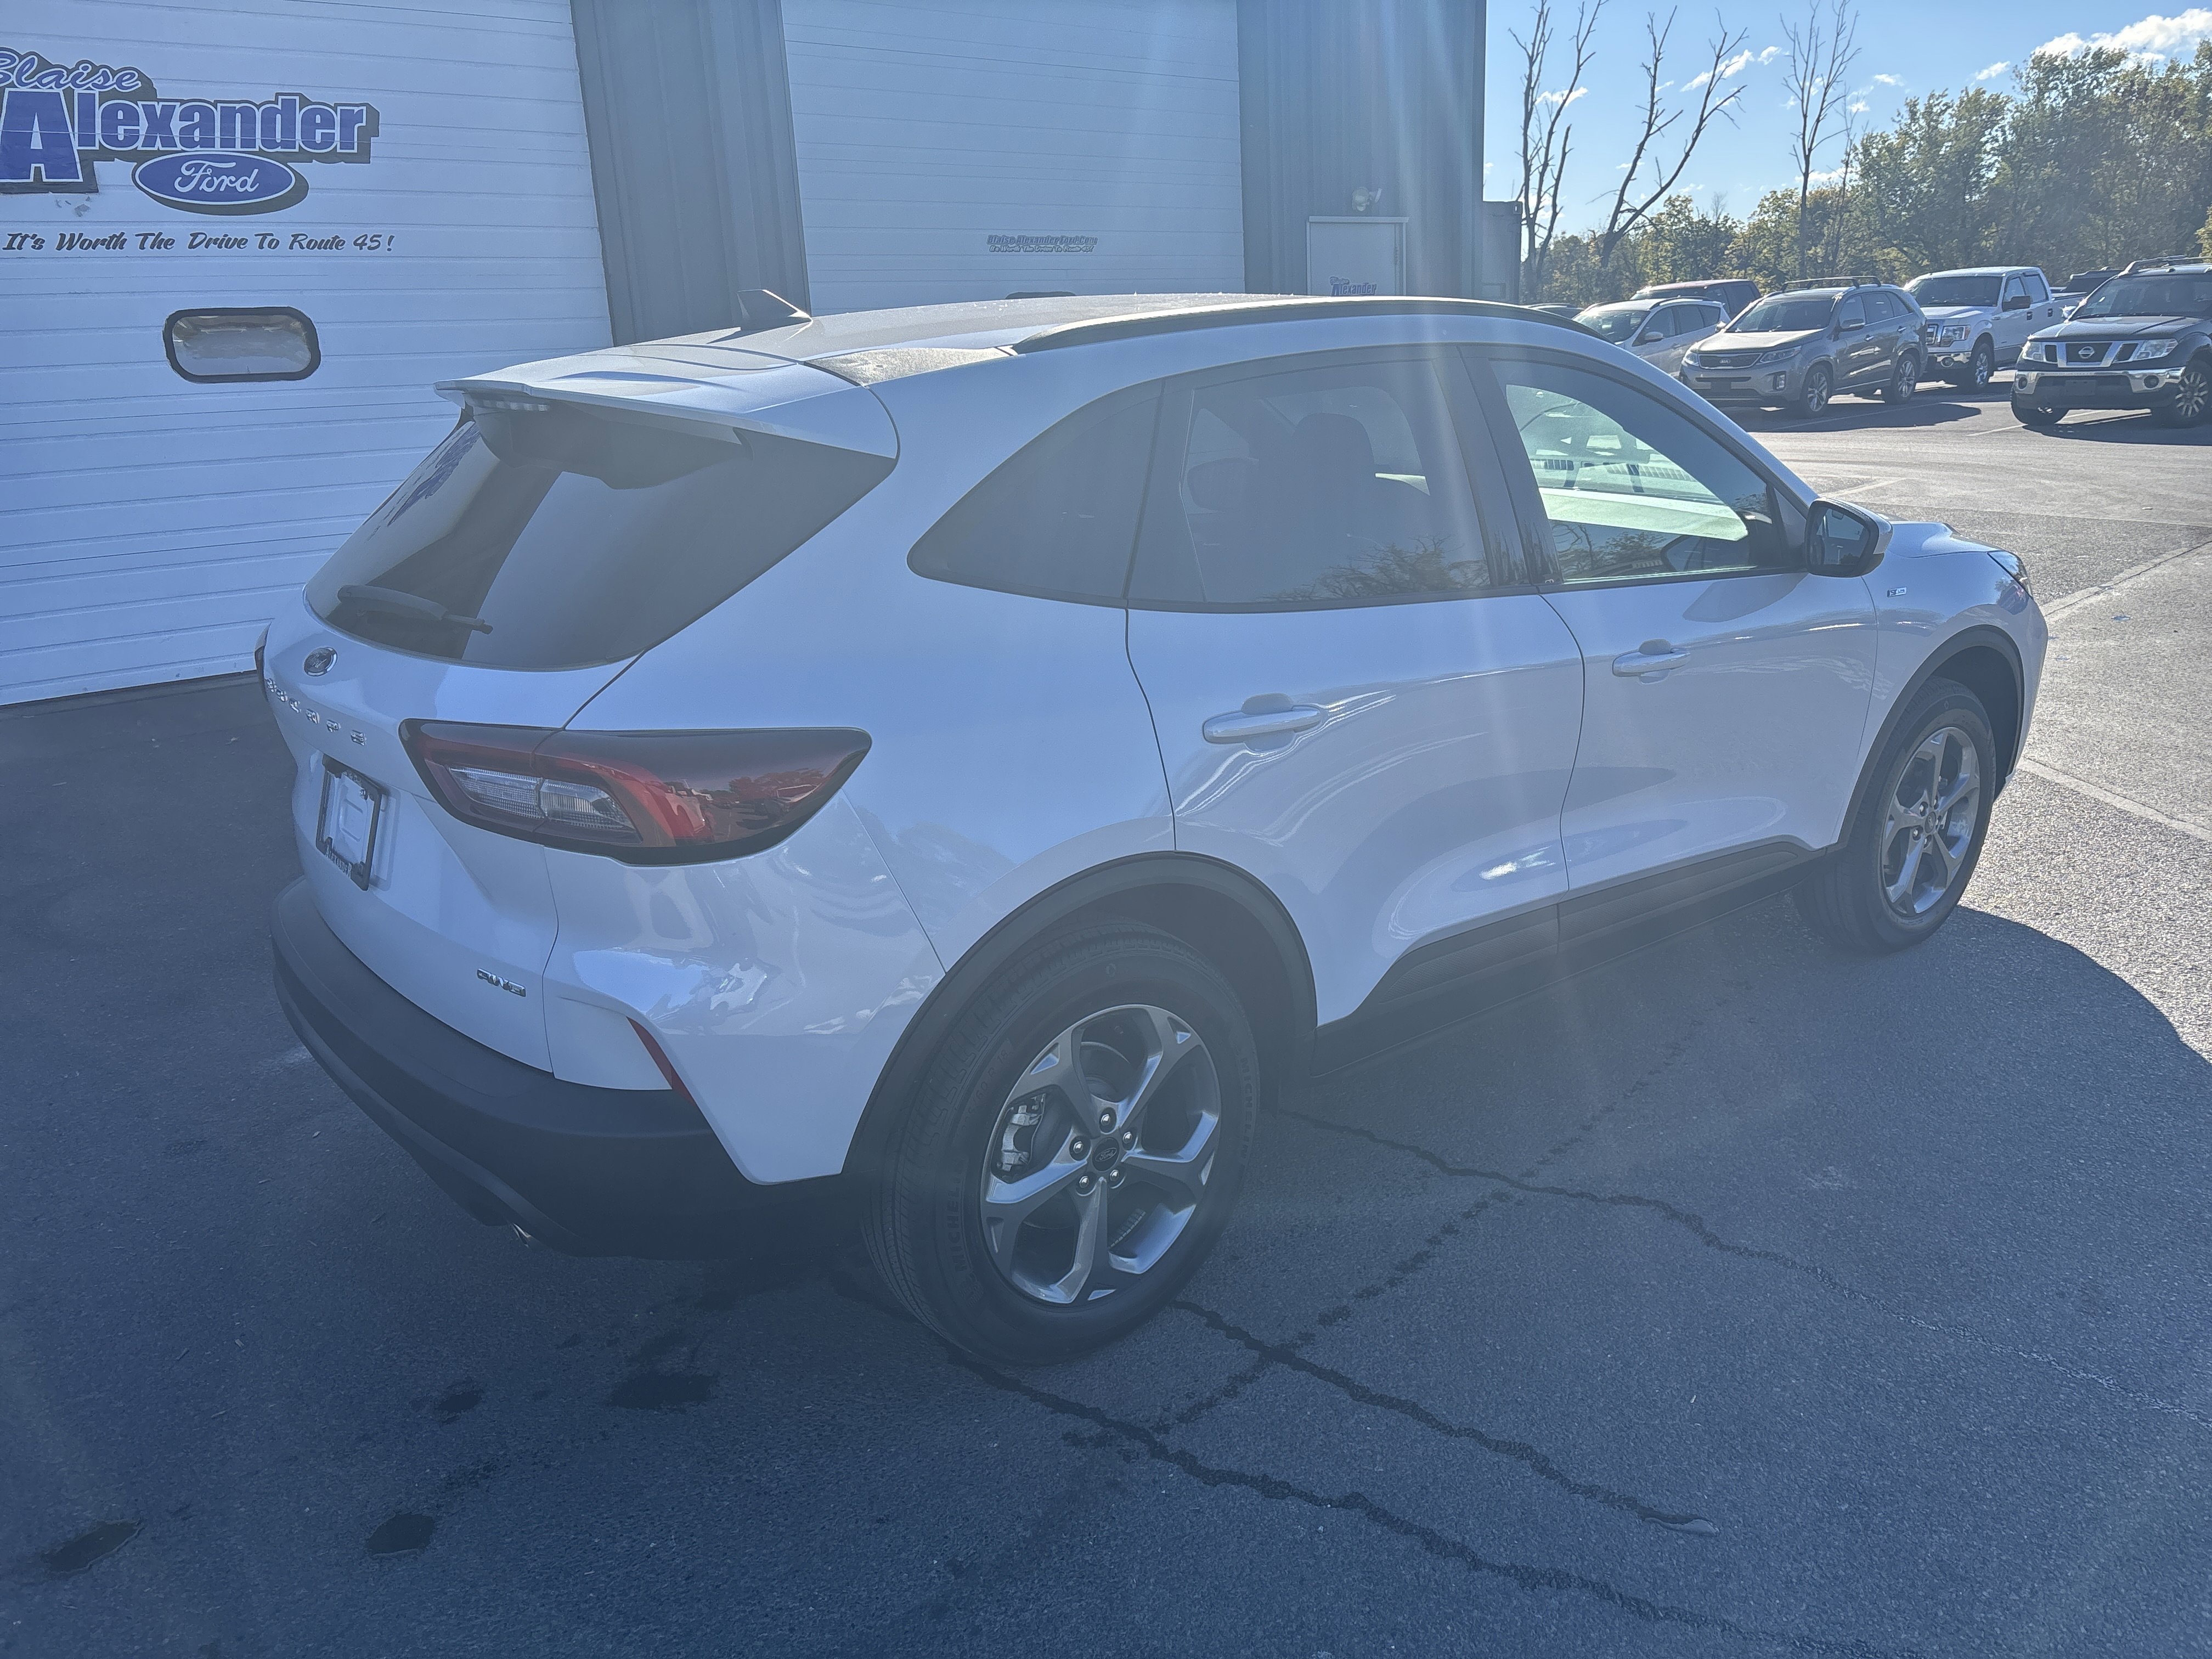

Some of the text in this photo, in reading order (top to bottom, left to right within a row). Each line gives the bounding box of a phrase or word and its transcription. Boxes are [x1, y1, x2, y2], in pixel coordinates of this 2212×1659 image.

[0, 88, 367, 182] Alexander
[174, 160, 259, 193] Ford
[2, 233, 46, 251] It's
[55, 232, 128, 251] Worth
[135, 232, 176, 250] The
[188, 232, 249, 250] Drive
[254, 232, 280, 250] To
[289, 233, 346, 251] Route
[1331, 282, 1377, 296] Alexander
[476, 968, 526, 997] AWD
[1240, 1057, 1253, 1159] MICHELIN
[1099, 1149, 1114, 1160] Ford
